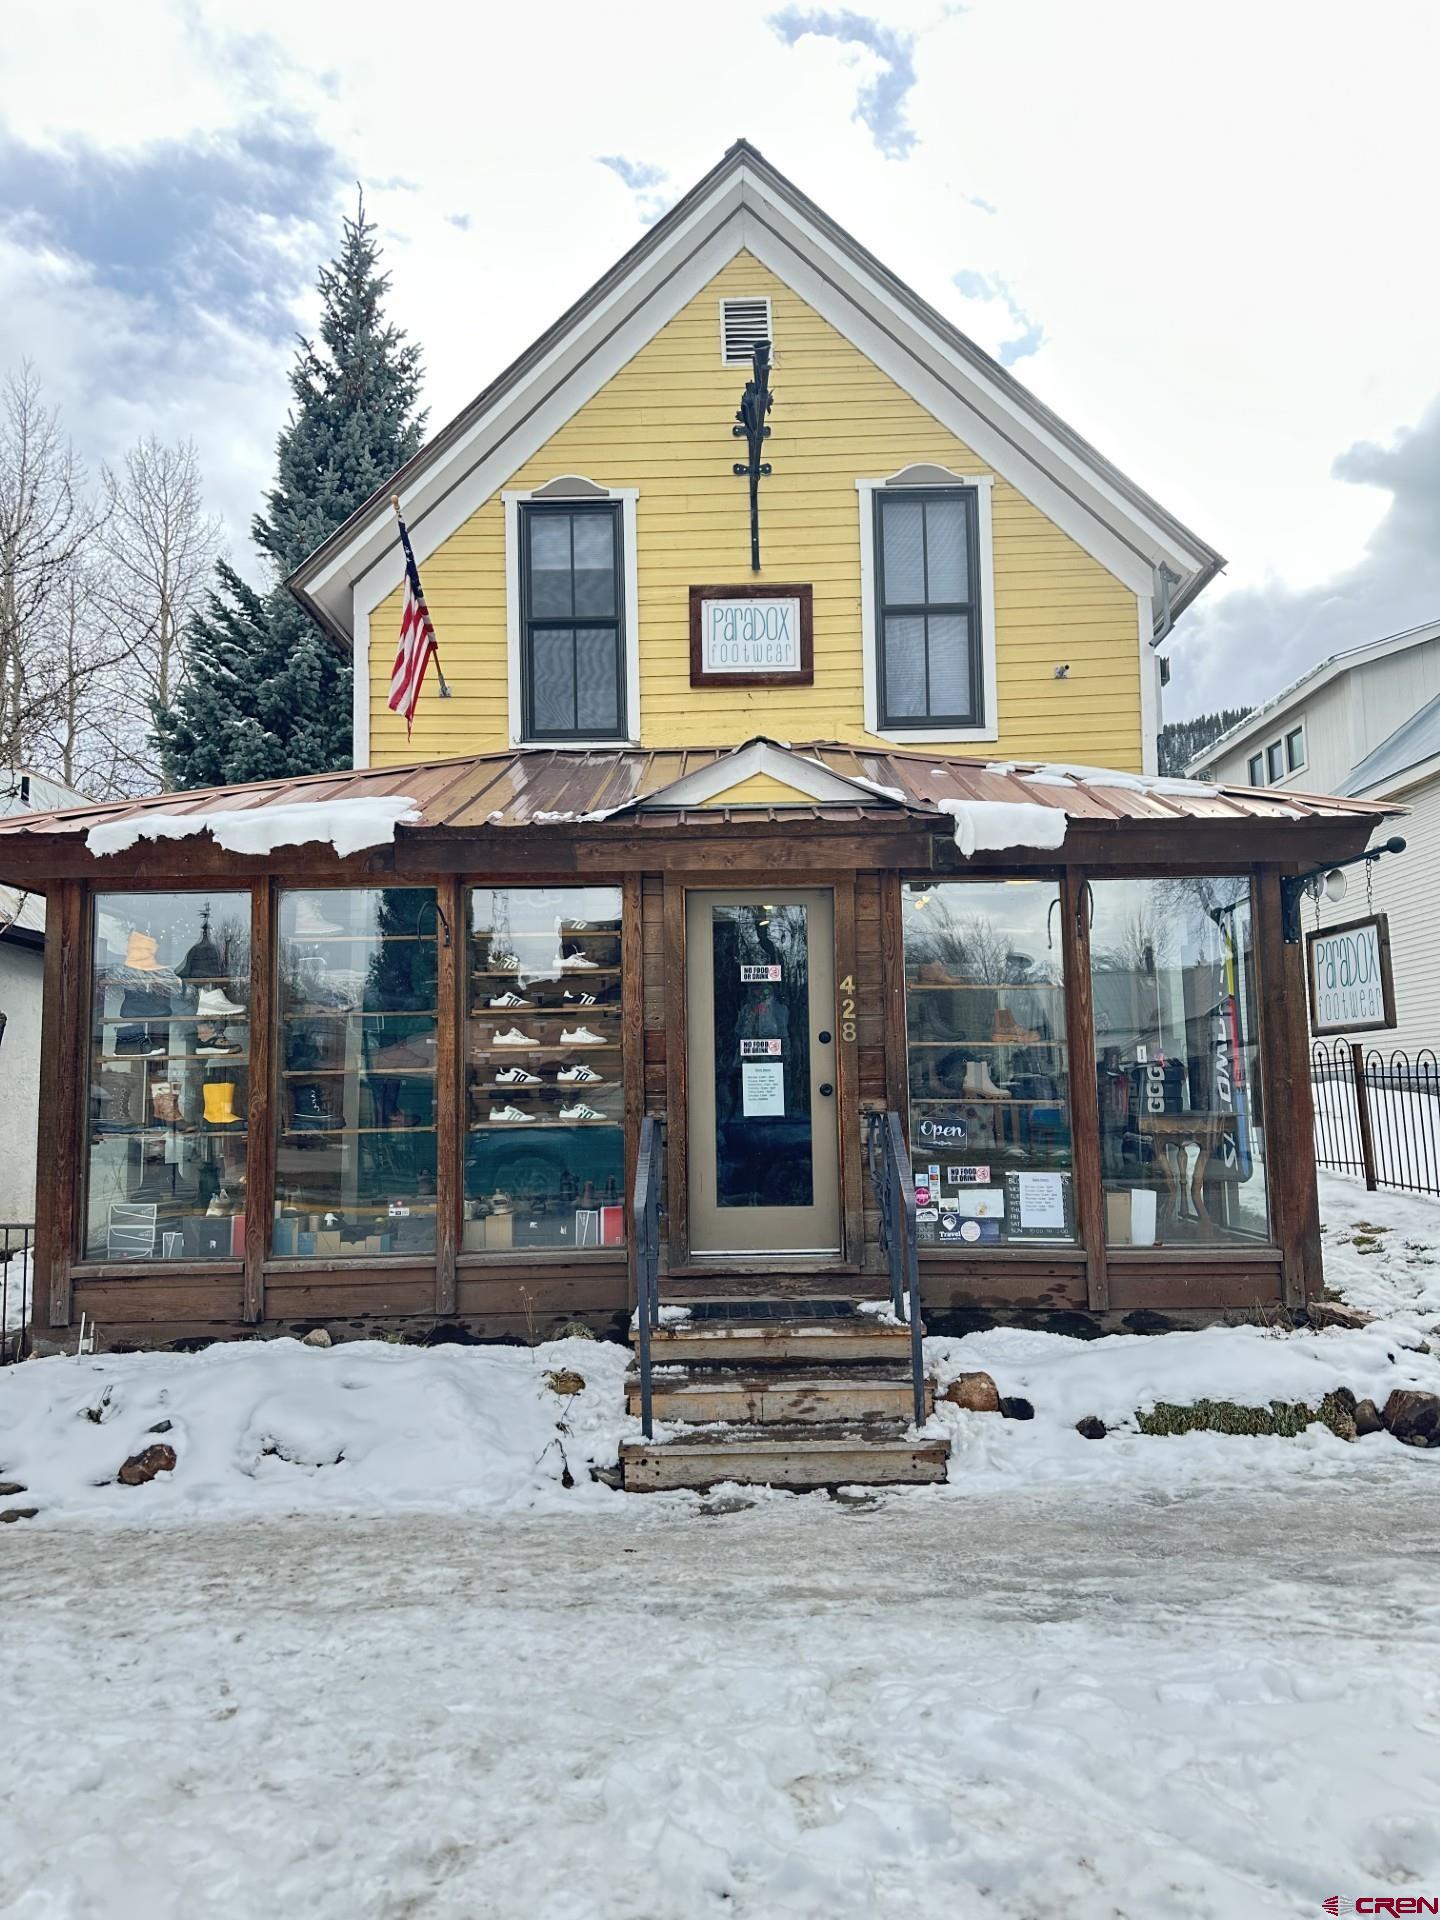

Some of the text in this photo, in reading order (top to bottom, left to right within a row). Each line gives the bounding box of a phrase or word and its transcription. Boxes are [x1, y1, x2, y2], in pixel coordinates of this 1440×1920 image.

[711, 643, 792, 663] footwear
[840, 974, 856, 1042] 428
[1318, 987, 1382, 1022] footwear
[920, 1120, 966, 1140] Open
